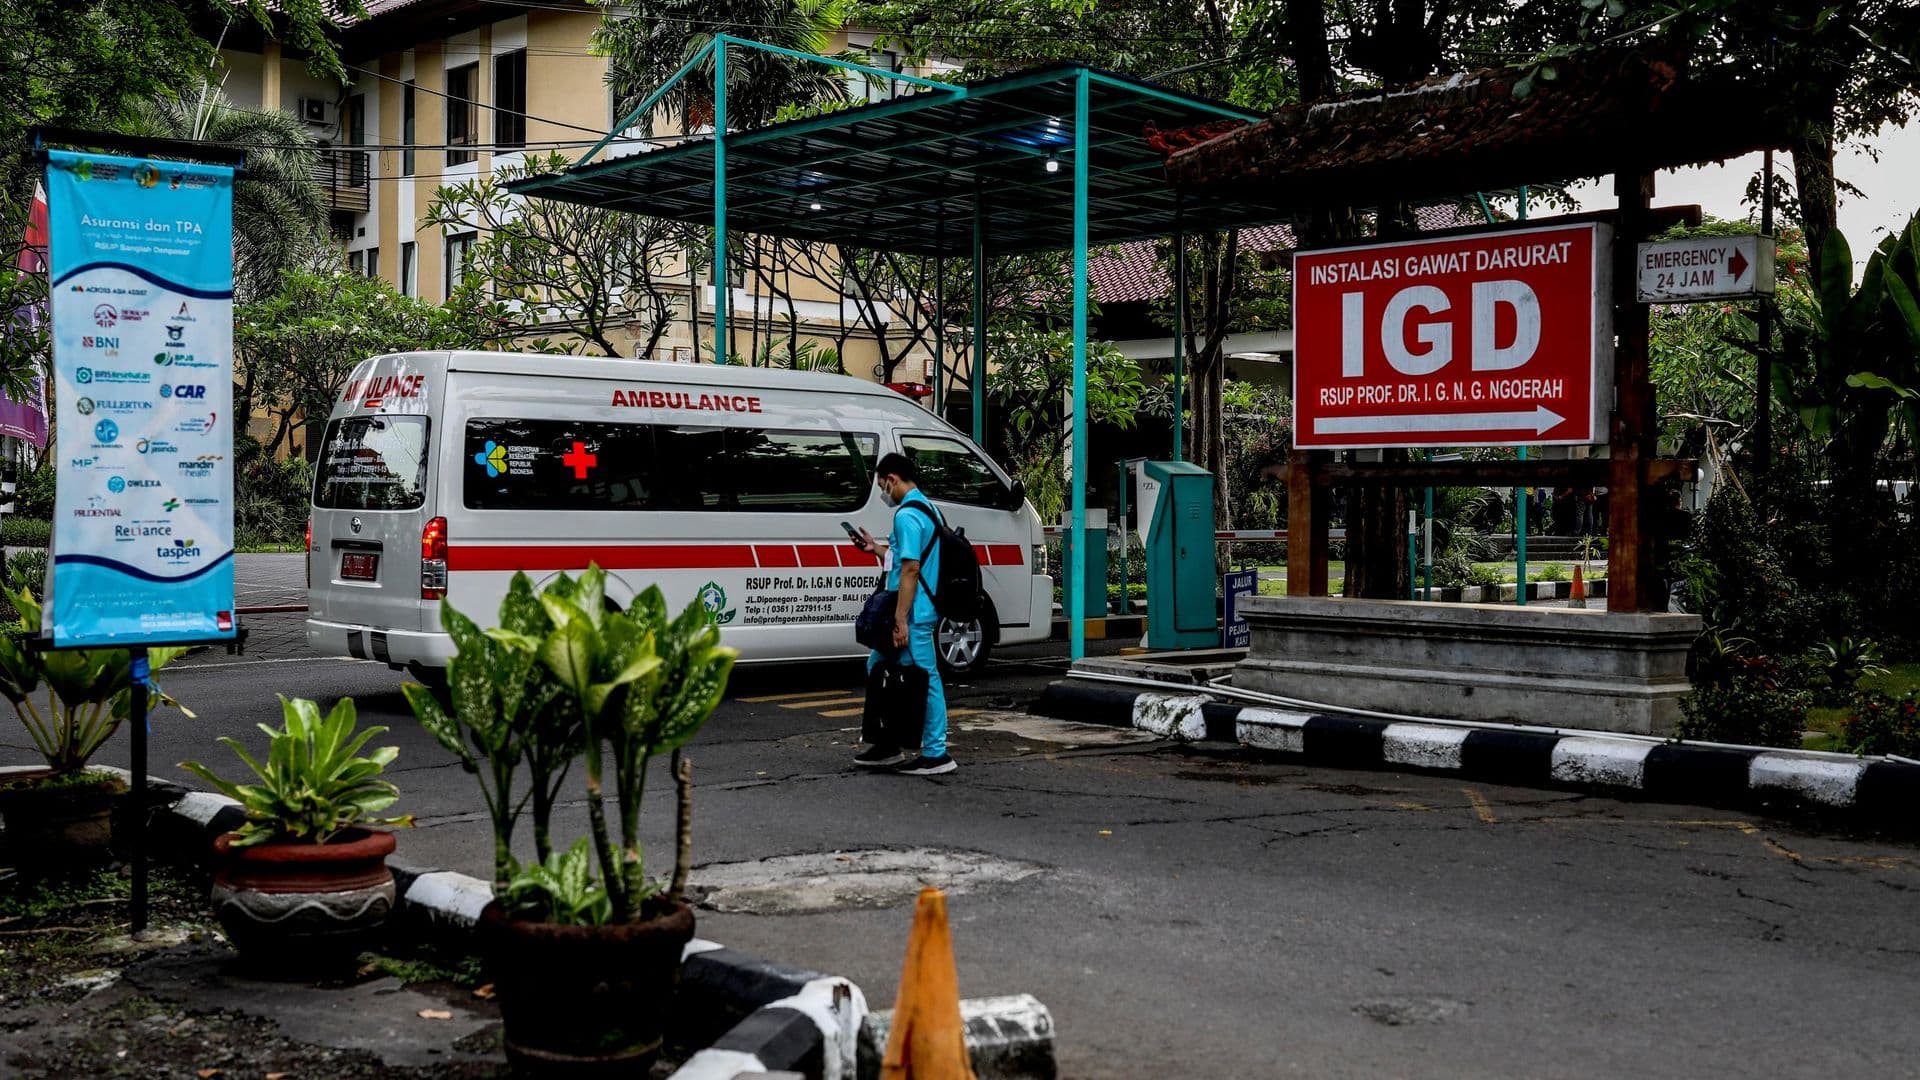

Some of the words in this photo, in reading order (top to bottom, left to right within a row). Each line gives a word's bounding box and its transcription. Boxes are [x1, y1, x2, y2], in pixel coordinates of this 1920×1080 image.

[81, 214, 140, 230] Asuransi
[144, 217, 170, 232] dan
[175, 220, 203, 235] TPA
[1311, 258, 1400, 286] INSTALASI
[1405, 251, 1471, 277] GAWAT
[1476, 242, 1572, 271] DARURAT
[1646, 248, 1726, 269] EMERGENCY
[1657, 272, 1674, 288] 24
[1680, 270, 1714, 287] JAM
[1342, 279, 1541, 377] IGD
[95, 336, 119, 349] BNI
[174, 385, 206, 398] CAR
[1320, 385, 1354, 406] RSUP
[1357, 384, 1394, 405] PROF.
[1398, 383, 1420, 403] DR.
[1490, 379, 1563, 400] NGOERAH
[96, 400, 152, 409] FULLERTON
[612, 390, 762, 413] AMBULANCE
[74, 509, 122, 517] PRUDENTIAL
[157, 546, 200, 559] taspen
[746, 577, 771, 590] RSUP
[774, 576, 794, 590] Prof.
[797, 576, 808, 589] Dr.
[844, 575, 880, 588] NGOERA
[1232, 575, 1253, 590] JALUR
[745, 595, 798, 605] JL.Diponegoro
[804, 594, 837, 604] Denpasar
[842, 594, 859, 602] BALI
[745, 606, 761, 615] Telp
[795, 604, 832, 612] 227911-15
[743, 614, 861, 624] info@profngoerahhospitalbali.co
[1228, 624, 1250, 636] PEJALA
